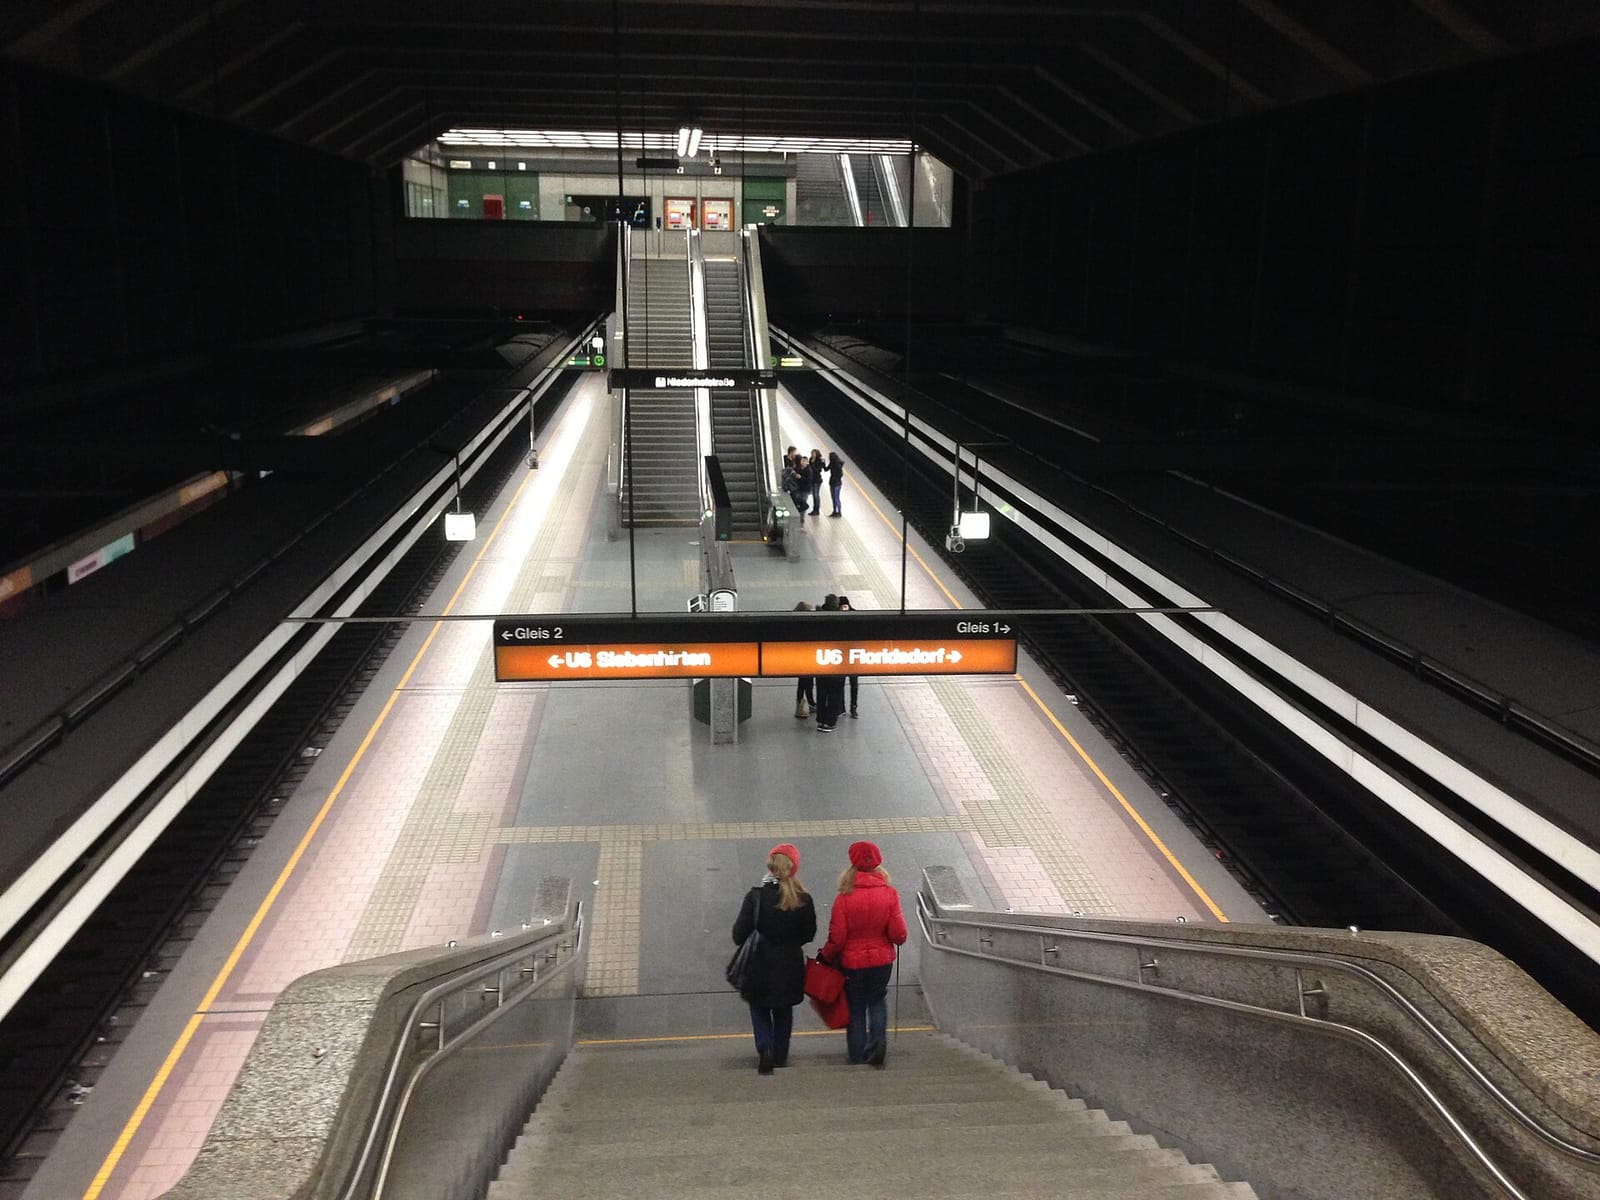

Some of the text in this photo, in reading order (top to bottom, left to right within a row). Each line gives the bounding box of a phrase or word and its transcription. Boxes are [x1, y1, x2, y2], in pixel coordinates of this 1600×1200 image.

[515, 627, 563, 640] Gleis 2
[956, 622, 1000, 634] Gleis 1
[565, 650, 711, 668] U6 Siebenhirten
[815, 648, 946, 665] U6 Floridsdorf
